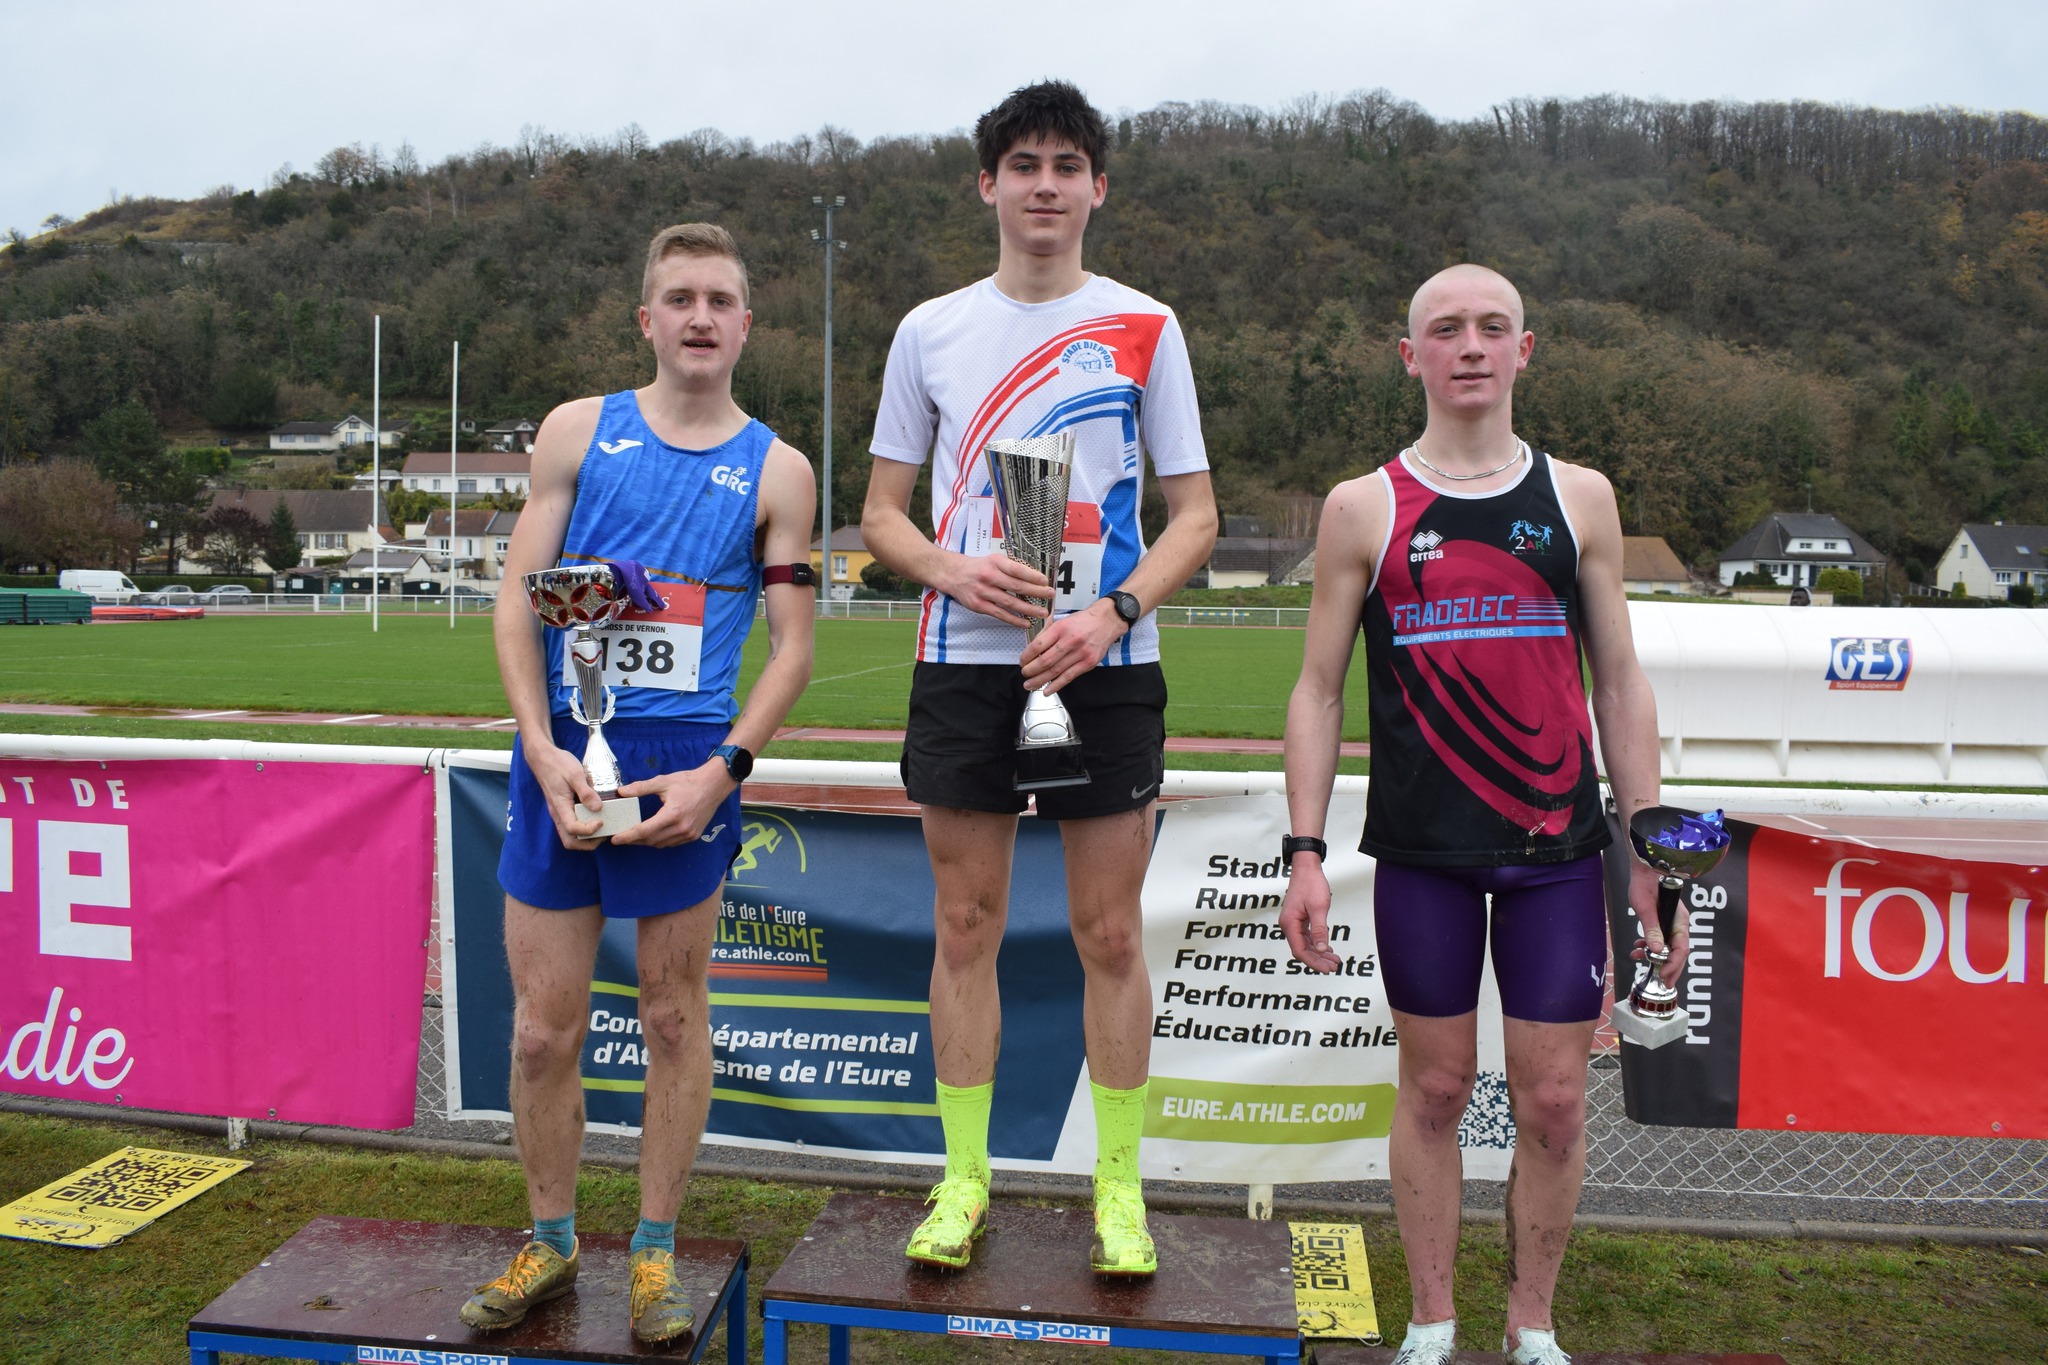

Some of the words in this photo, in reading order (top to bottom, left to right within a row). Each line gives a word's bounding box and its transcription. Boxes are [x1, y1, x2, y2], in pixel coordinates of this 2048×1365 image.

[1062, 342, 1082, 364] STADE
[1084, 341, 1113, 368] DIEPPOIS
[711, 465, 750, 495] GRC
[1515, 536, 1544, 550] 2AR
[1057, 560, 1076, 595] 4
[1393, 595, 1515, 630] FRADELEC
[636, 625, 666, 633] VERNON
[1395, 631, 1451, 644] EQUIPEMENTS
[1453, 628, 1514, 639] ELECTRIQUES
[602, 637, 675, 675] 138
[1833, 639, 1905, 681] GES
[70, 778, 129, 810] DE
[1207, 855, 1292, 878] Stade
[739, 903, 757, 920] de
[1813, 858, 2048, 984] fou
[711, 946, 810, 963] re.athle.com
[713, 918, 828, 964] LETISME
[1174, 948, 1277, 974] Forme
[1685, 884, 1728, 1044] running
[1163, 981, 1371, 1014] Performance
[0, 986, 135, 1090] die
[709, 1023, 919, 1054] épartemental
[1153, 1010, 1311, 1047] Éducation
[779, 1059, 817, 1083] de
[824, 1060, 912, 1087] l'Eure
[1162, 1095, 1366, 1124] EURE.ATHLE.COM
